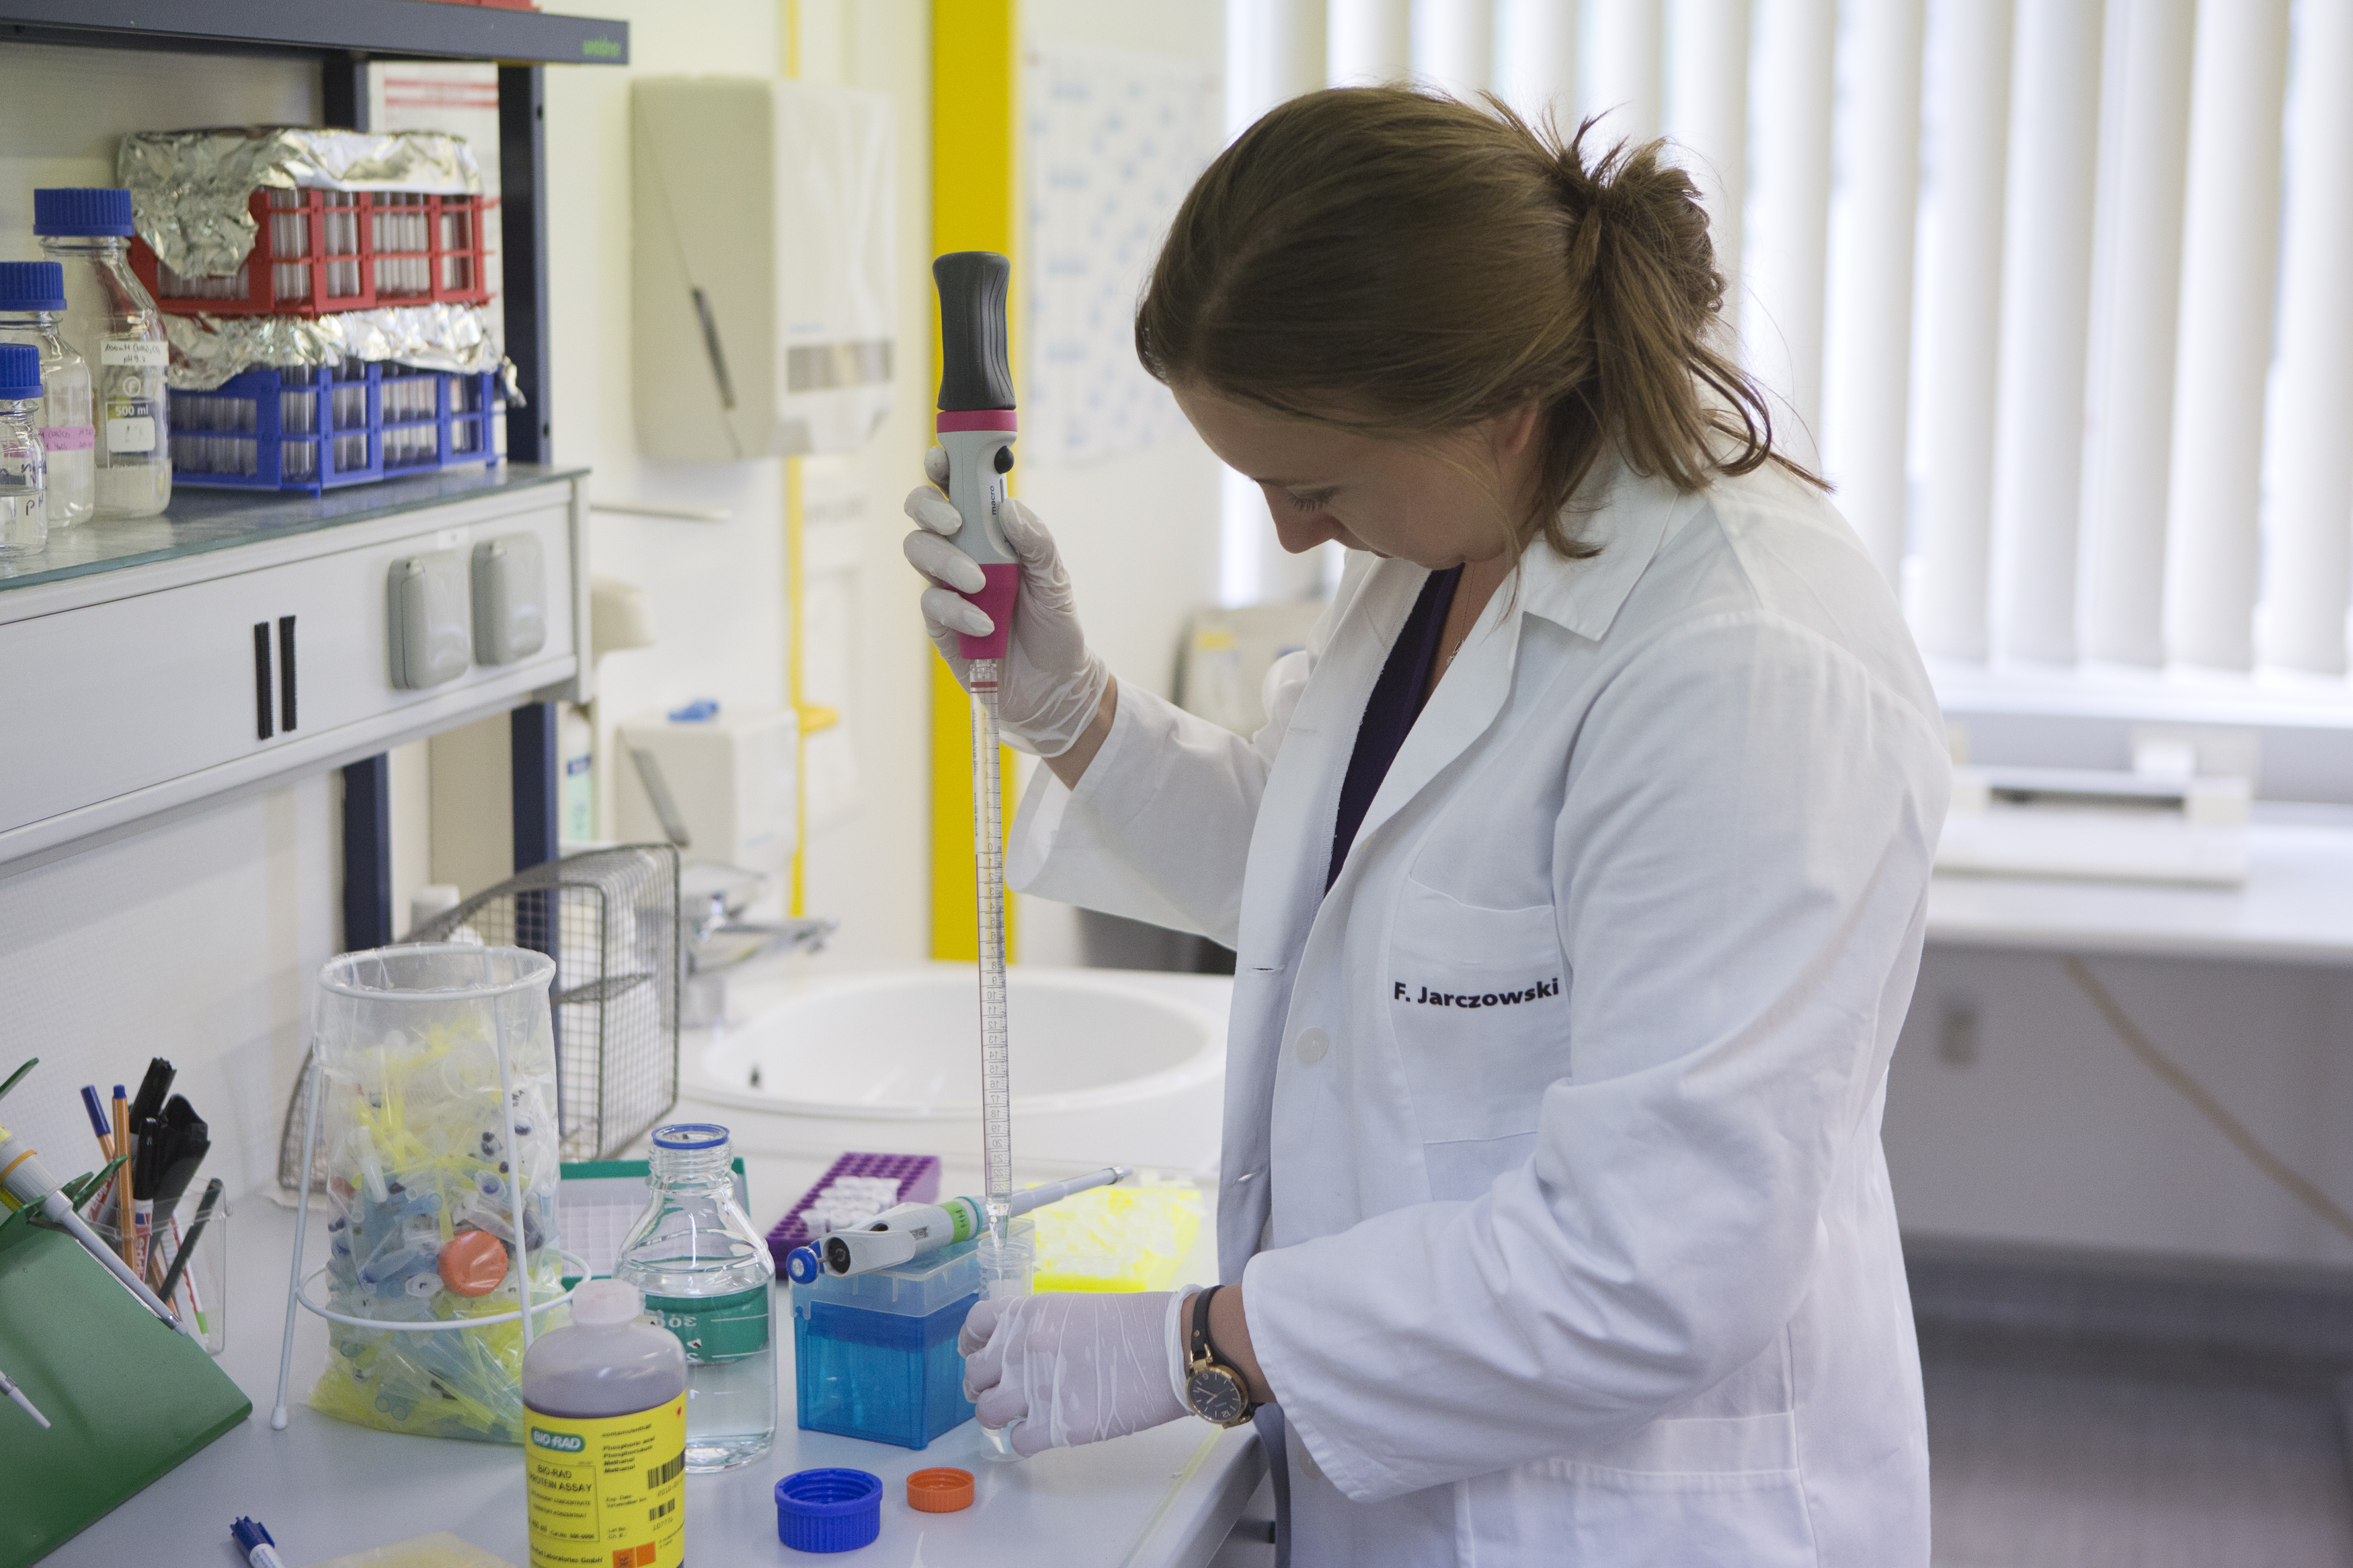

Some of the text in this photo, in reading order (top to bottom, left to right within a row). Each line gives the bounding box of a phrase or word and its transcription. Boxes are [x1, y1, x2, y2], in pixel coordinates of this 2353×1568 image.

[115, 403, 149, 416] 500 ml
[1394, 977, 1559, 1008] F. Jarczowski
[533, 1430, 582, 1449] BIO-RAD
[538, 1464, 572, 1479] BIO-RAD
[559, 1482, 592, 1492] ASSAY
